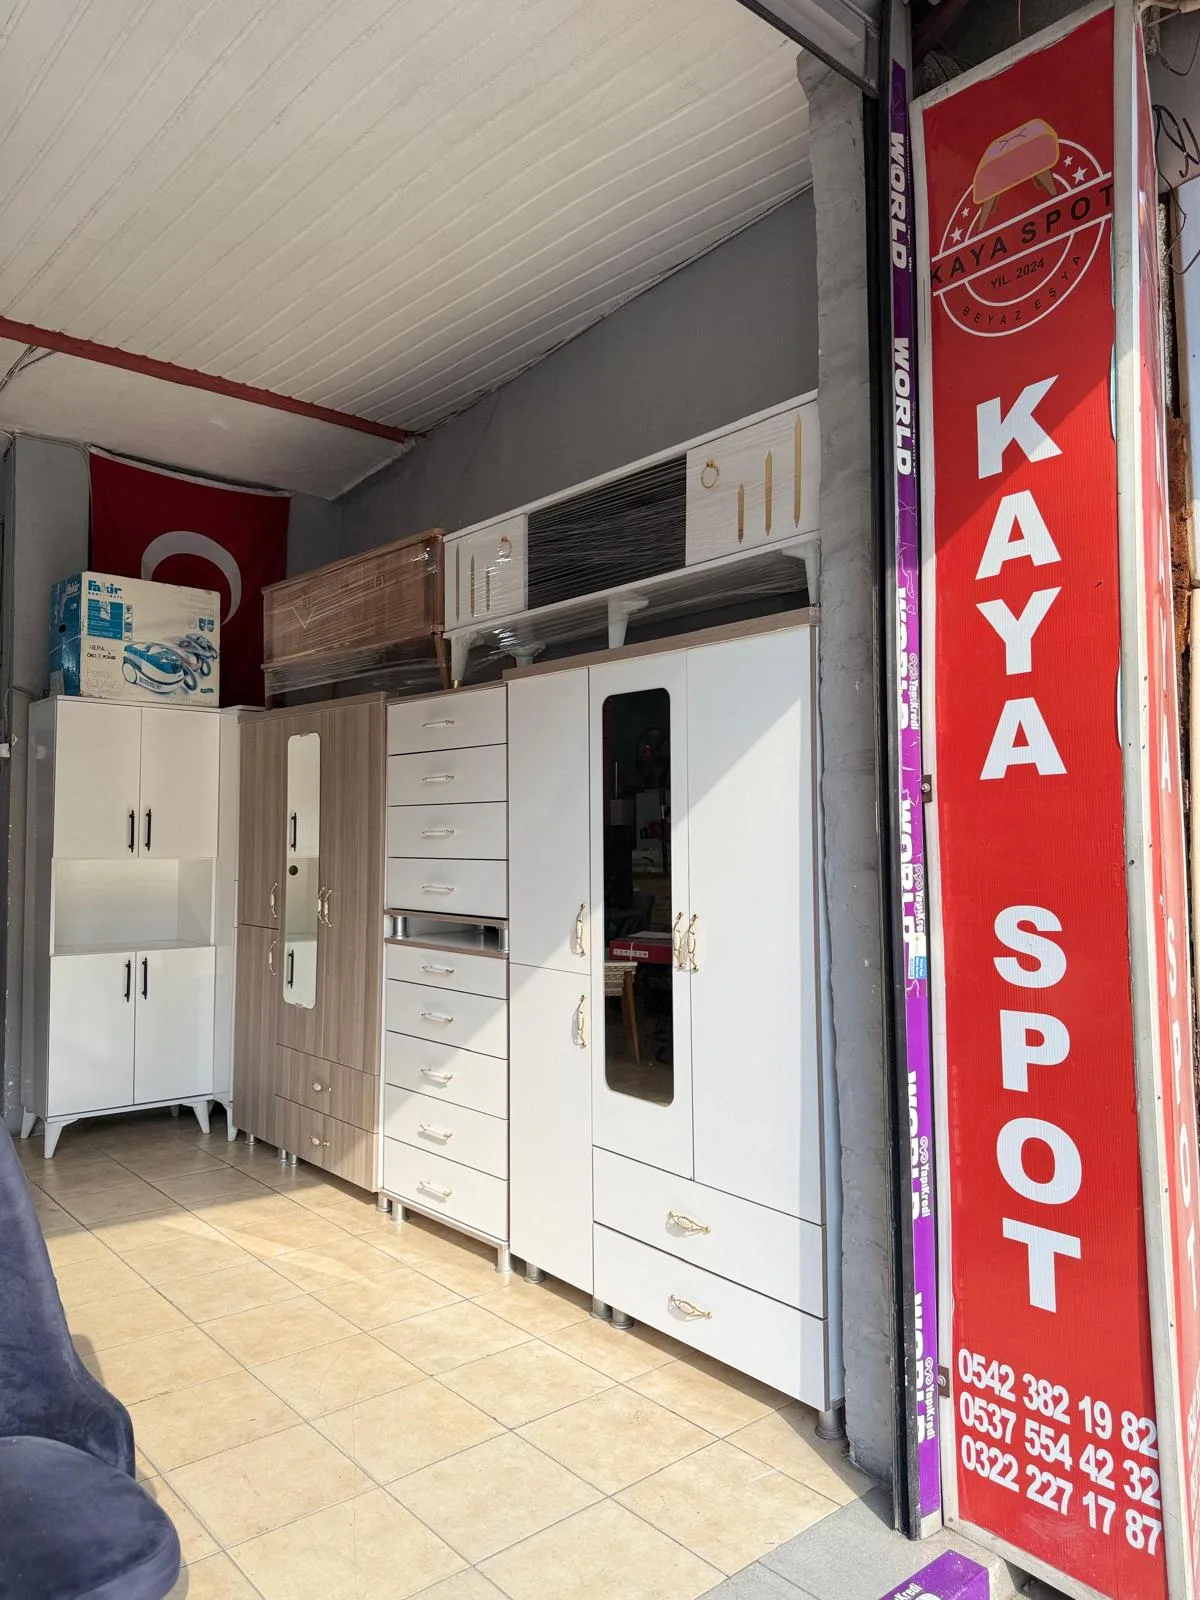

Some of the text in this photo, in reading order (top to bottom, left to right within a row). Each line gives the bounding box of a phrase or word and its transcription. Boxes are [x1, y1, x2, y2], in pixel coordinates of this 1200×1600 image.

[891, 132, 907, 269] WORLD
[930, 184, 1114, 288] KAYA SPOT
[962, 306, 1022, 325] BEYAZ
[990, 258, 1046, 290] YIL 2024
[895, 338, 911, 475] WORLD
[975, 374, 1082, 1313] KAYA SPOT
[958, 1348, 1159, 1460] 0542 382 19 82
[960, 1392, 1161, 1509] 0537 554 42 32
[961, 1435, 1162, 1556] 0322 227 17 87
